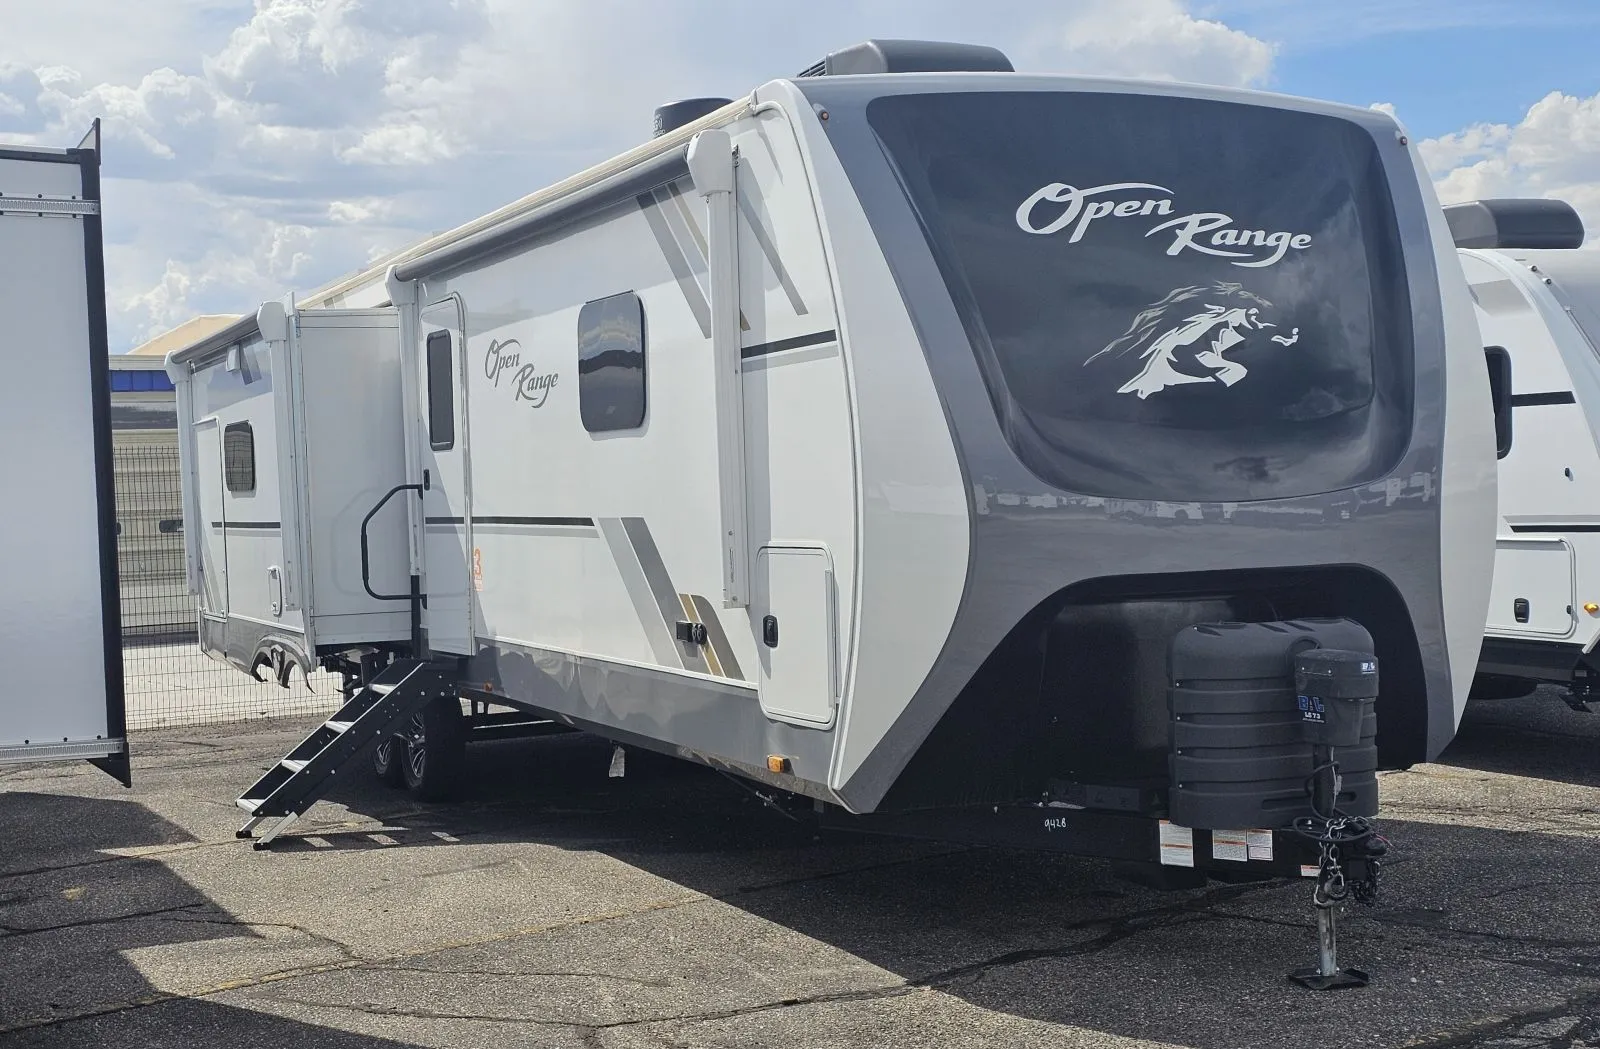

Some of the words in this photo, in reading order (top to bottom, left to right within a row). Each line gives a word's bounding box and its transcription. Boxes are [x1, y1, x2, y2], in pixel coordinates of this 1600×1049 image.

[1015, 183, 1175, 243] Open
[1145, 213, 1312, 267] Range
[484, 338, 521, 388] Open
[511, 363, 559, 408] Range
[1044, 817, 1067, 832] 9428
